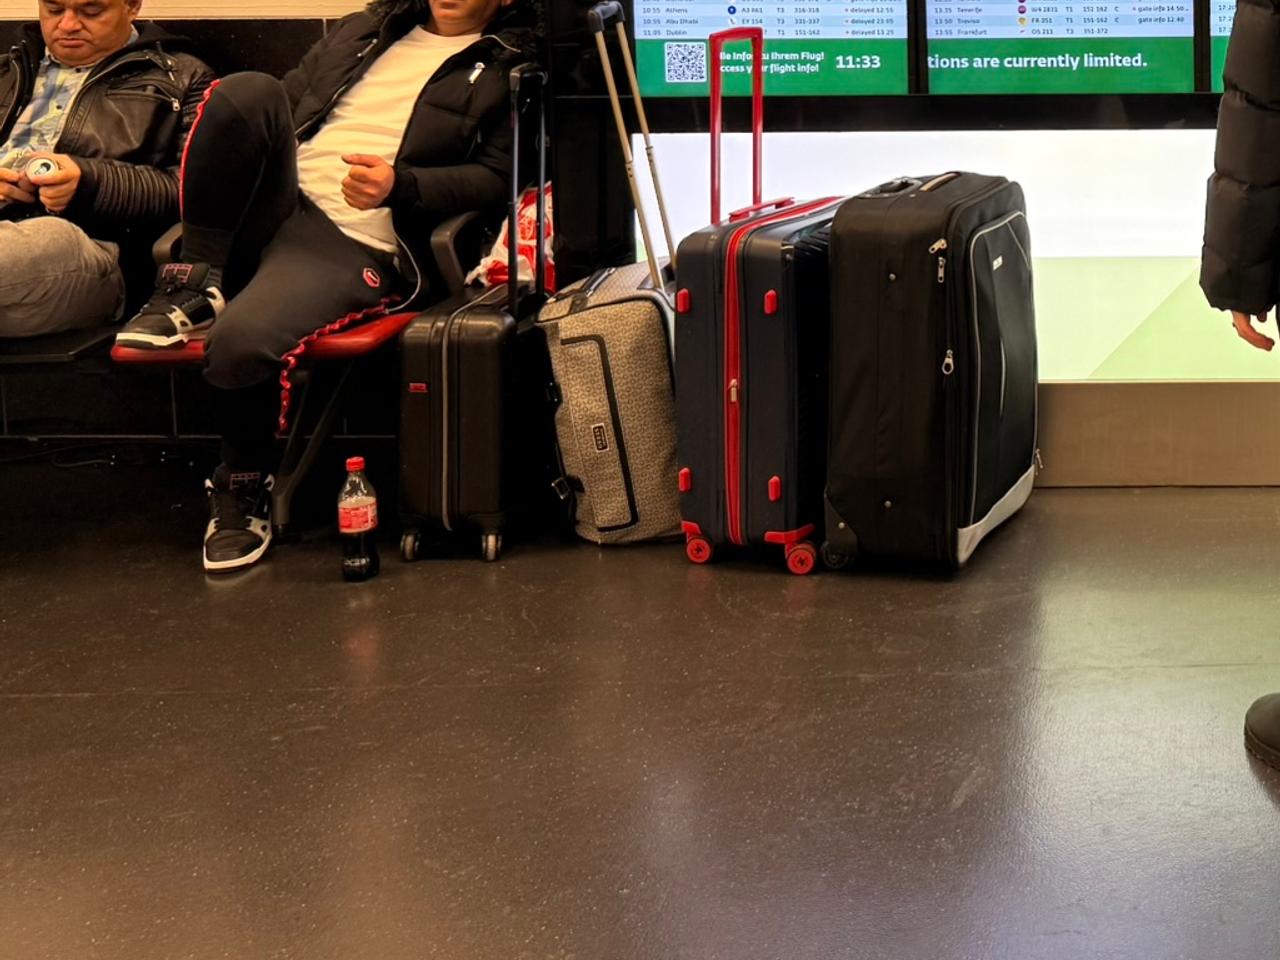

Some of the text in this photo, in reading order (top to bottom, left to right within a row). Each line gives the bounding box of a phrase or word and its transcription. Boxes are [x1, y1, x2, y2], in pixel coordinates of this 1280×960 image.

[771, 52, 799, 60] Ihrem
[801, 52, 824, 61] Flug!
[836, 55, 881, 68] 11:33
[973, 56, 999, 68] are
[1004, 53, 1080, 70] currently
[1084, 52, 1147, 67] limited.
[770, 63, 796, 73] flight
[797, 63, 819, 73] info!
